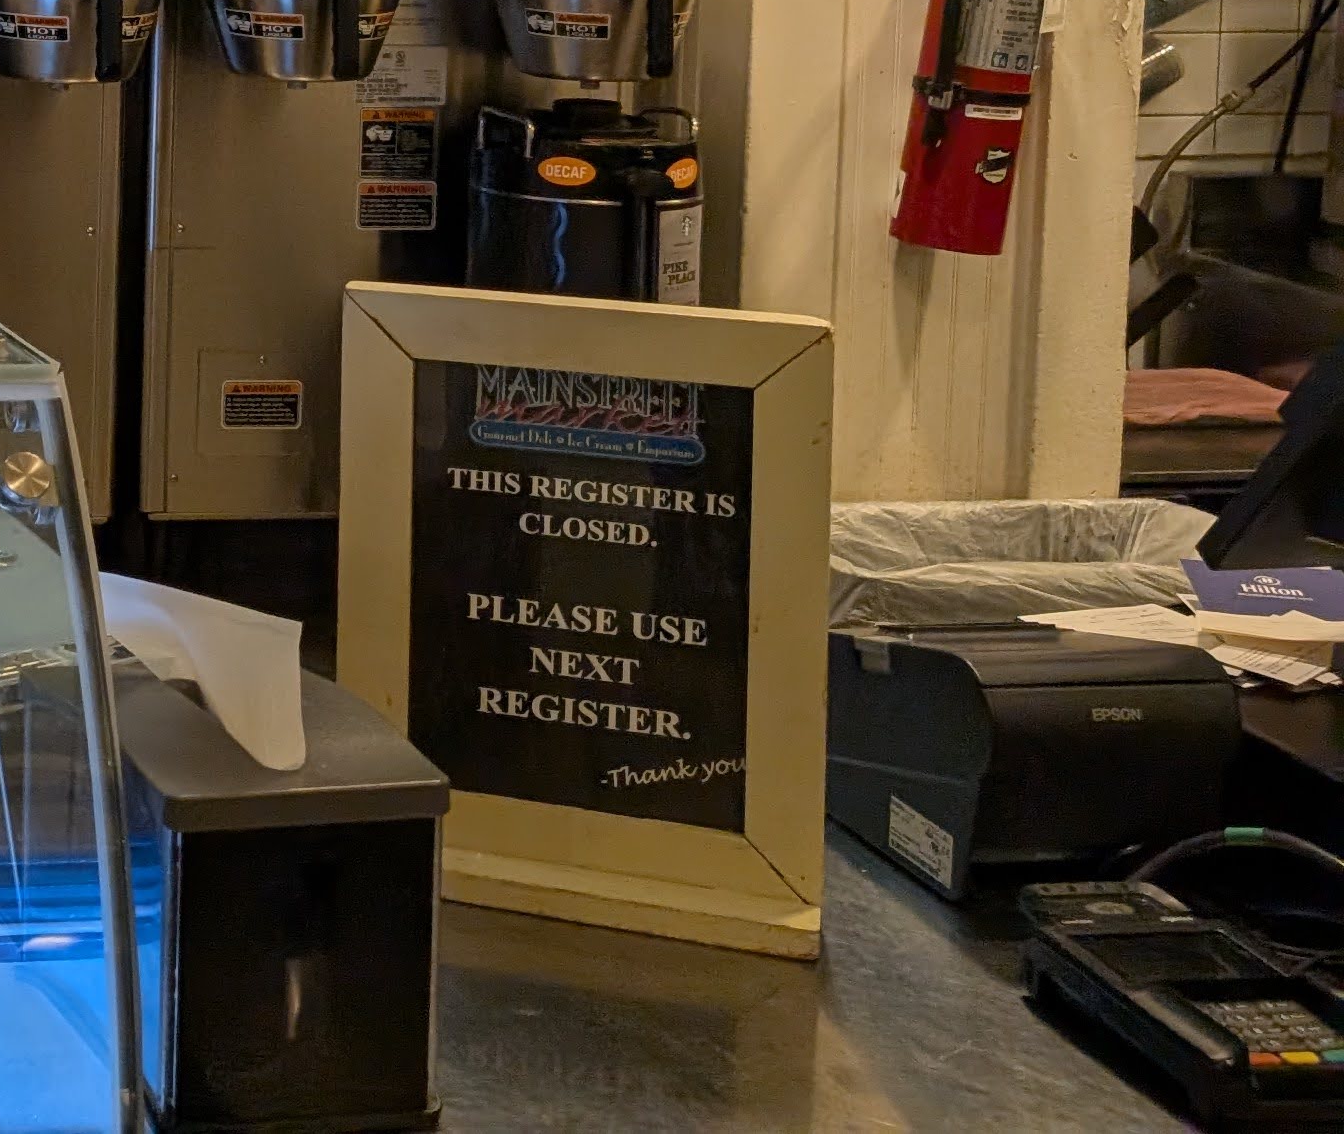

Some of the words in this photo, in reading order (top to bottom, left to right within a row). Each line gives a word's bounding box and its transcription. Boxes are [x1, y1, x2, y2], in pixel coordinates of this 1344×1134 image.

[26, 26, 60, 36] HOT
[261, 24, 294, 34] HOT
[565, 24, 598, 34] HOT
[544, 164, 588, 180] DECAF
[670, 164, 696, 181] DECAF
[662, 260, 688, 275] PIKE
[527, 428, 553, 445] Deli
[447, 467, 522, 495] THIS
[528, 474, 697, 514] REGISTER
[703, 492, 737, 518] IS
[518, 511, 659, 549] CLOSED.
[1240, 583, 1304, 597] Hilton
[466, 592, 619, 636] PLEASE
[630, 610, 708, 647] USE
[528, 646, 641, 686] NEXT
[476, 685, 692, 741] REGISTER.
[1091, 707, 1142, 723] EPSON
[701, 757, 747, 784] you
